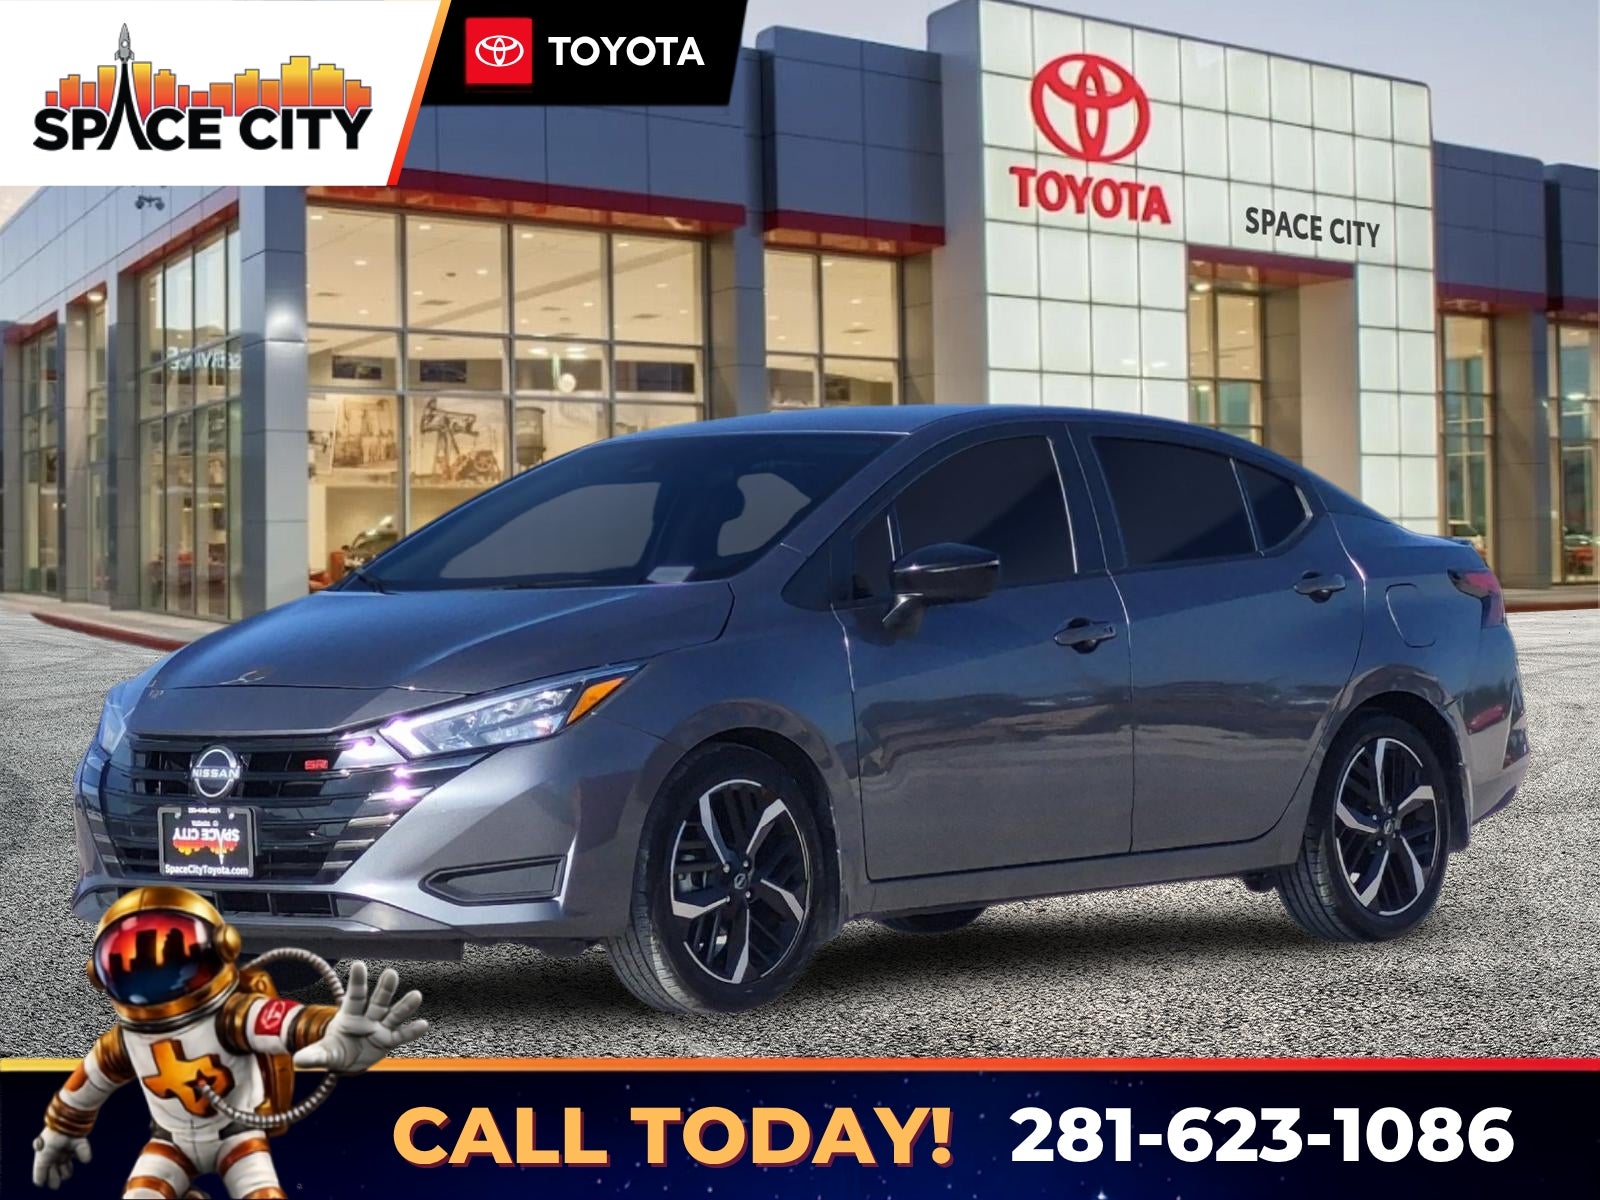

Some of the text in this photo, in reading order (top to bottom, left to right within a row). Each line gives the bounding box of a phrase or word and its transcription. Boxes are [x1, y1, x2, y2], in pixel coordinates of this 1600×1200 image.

[1008, 166, 1171, 225] TOYOTA
[1245, 206, 1381, 248] SPACE CITY
[304, 759, 329, 771] SR
[191, 767, 240, 780] NISSAN
[172, 827, 240, 842] SPACE CITY
[165, 863, 249, 876] SpaceCityToyota.com
